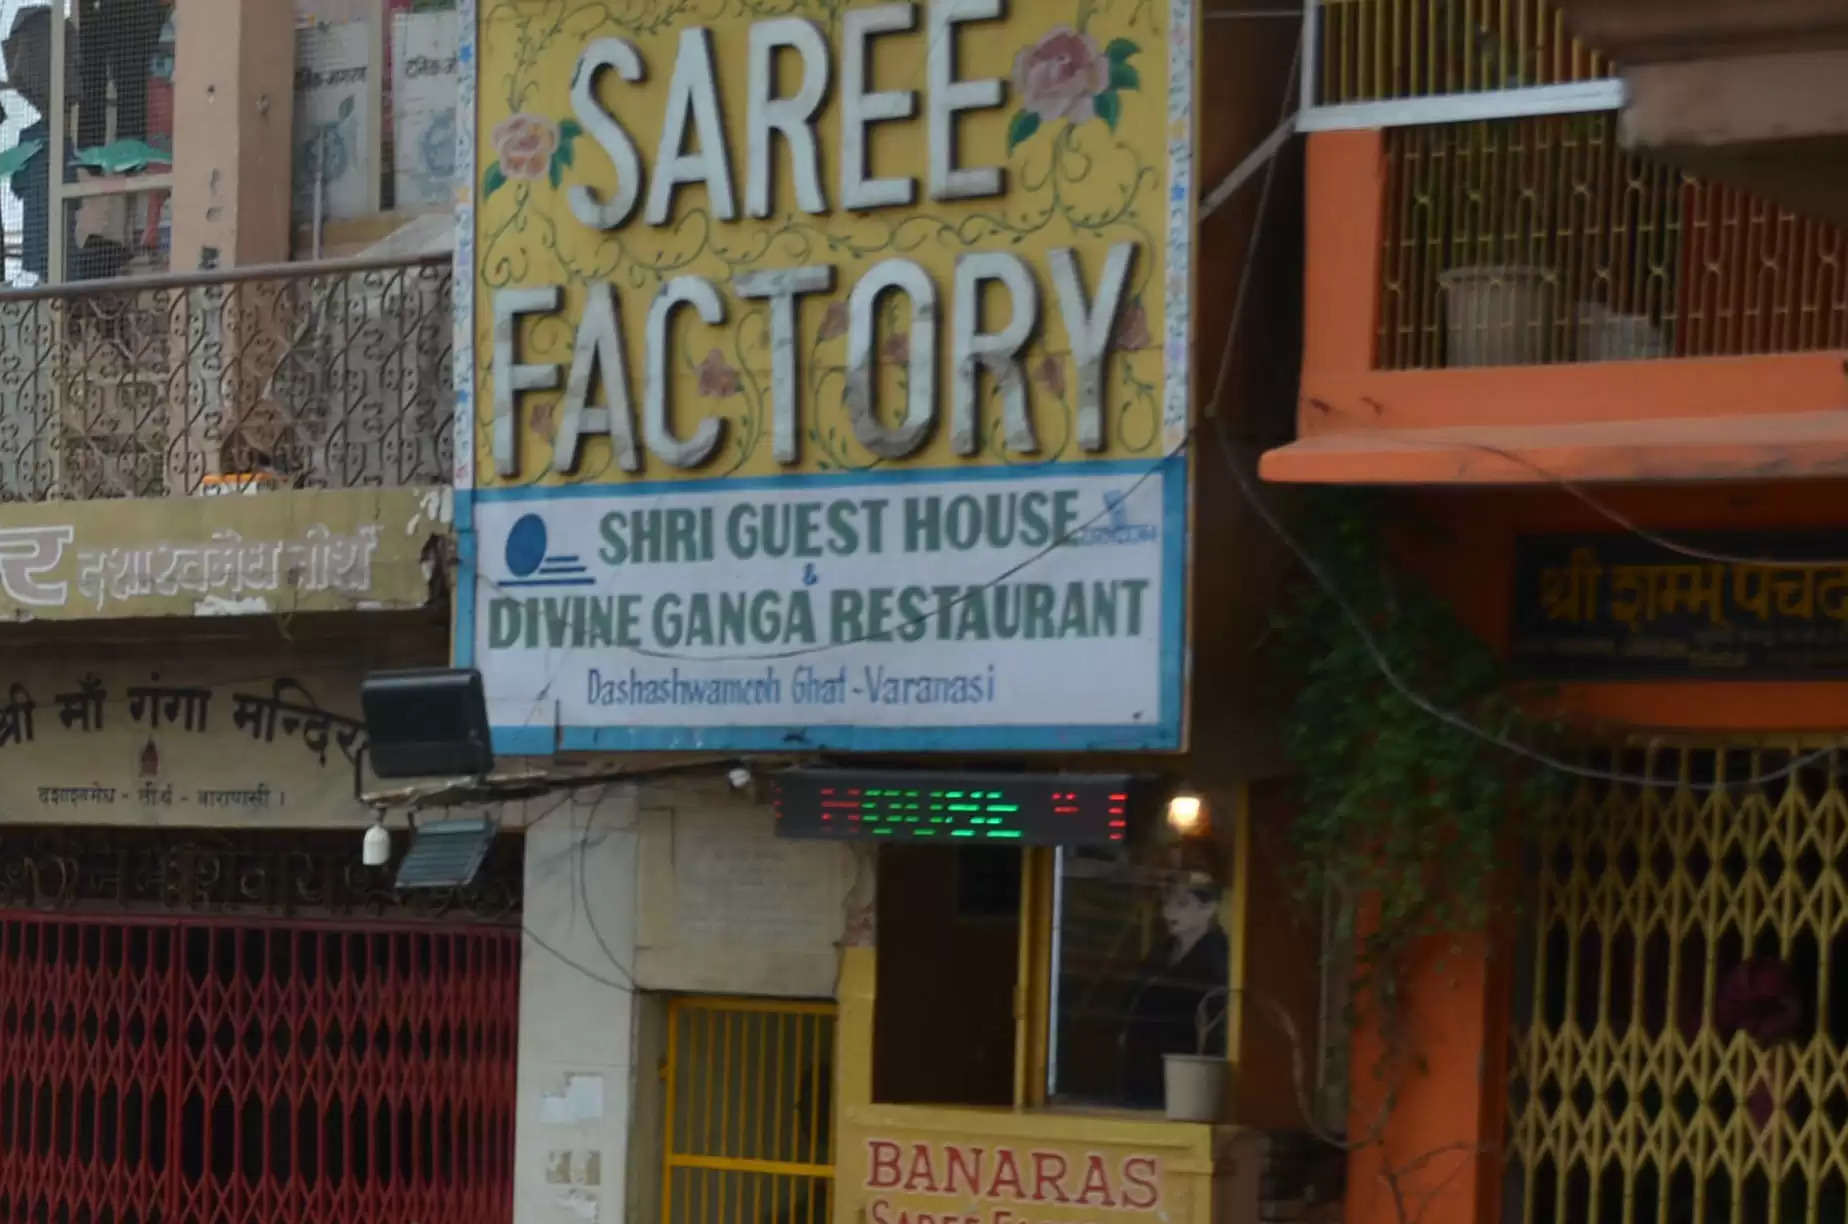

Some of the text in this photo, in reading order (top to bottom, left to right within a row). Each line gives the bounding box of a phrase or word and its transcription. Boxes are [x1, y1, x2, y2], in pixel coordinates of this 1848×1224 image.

[569, 0, 1010, 230] SAREE
[494, 242, 1138, 478] FACTORY
[599, 490, 1080, 566] SHRI GUEST HOUSE
[488, 578, 1149, 650] DIVINE GANGA RESTAURANT
[55, 671, 106, 733] माँ
[125, 671, 211, 733] गंगा
[791, 664, 847, 706] Ghat
[866, 1140, 1162, 1210] BANARAS
